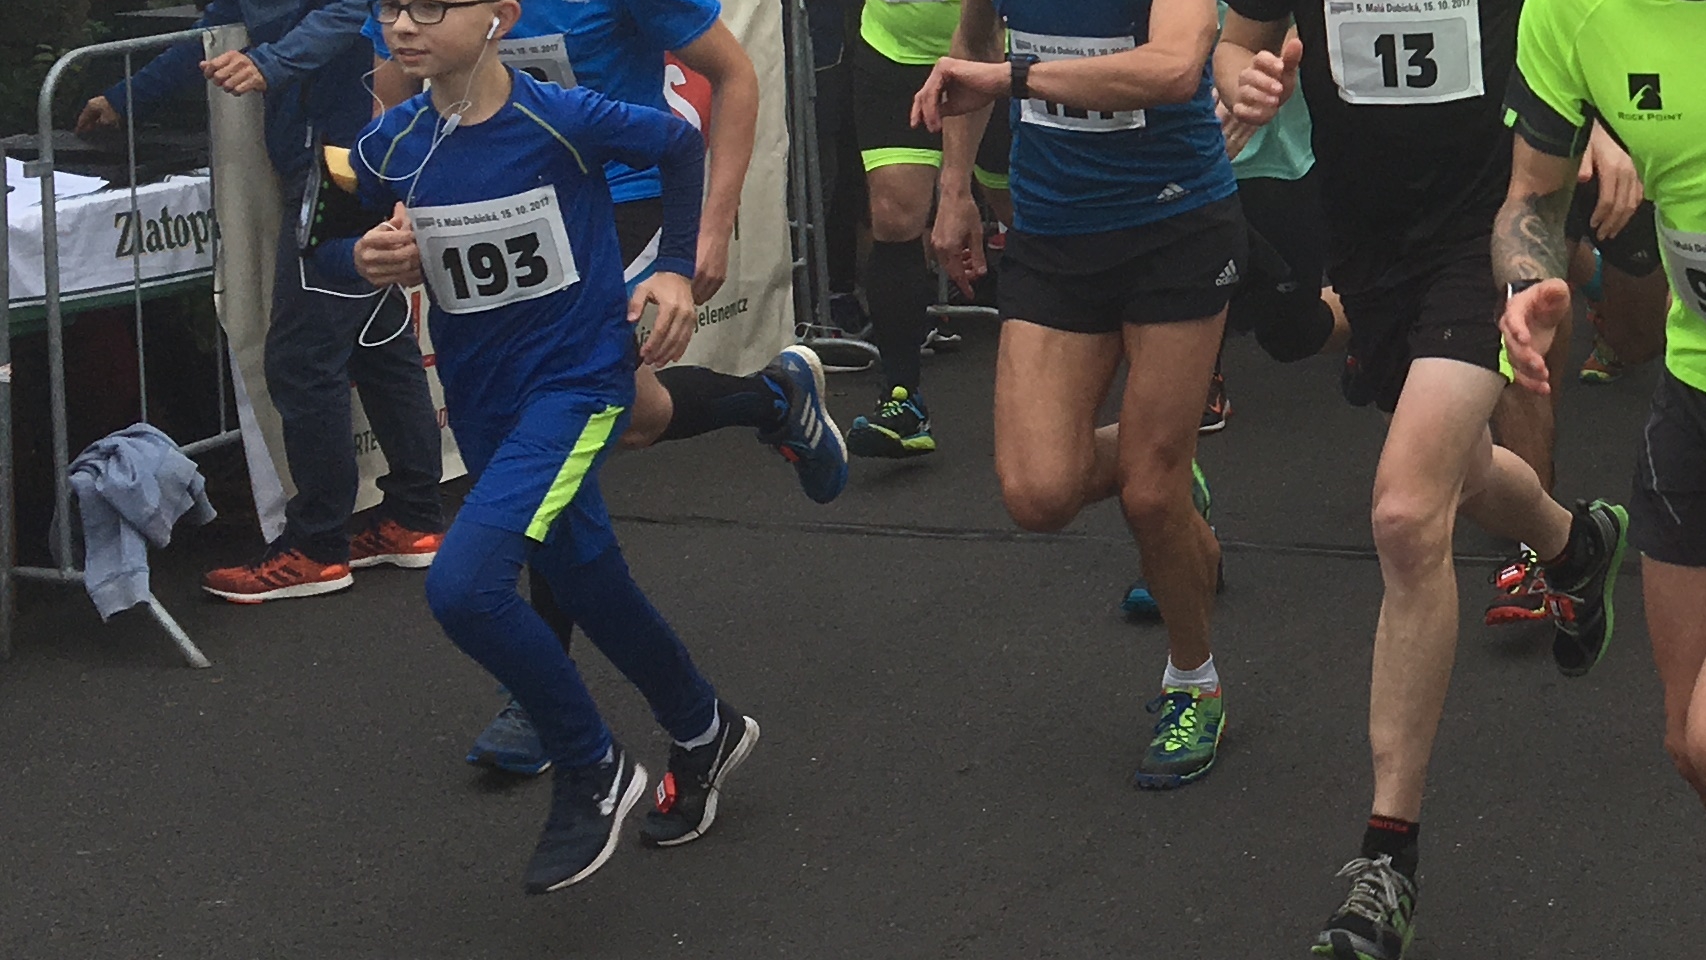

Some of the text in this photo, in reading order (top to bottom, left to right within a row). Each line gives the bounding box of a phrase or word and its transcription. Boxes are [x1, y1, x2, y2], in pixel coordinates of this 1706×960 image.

[1373, 32, 1439, 89] 13
[529, 196, 550, 210] 2017
[441, 231, 549, 300] 193
